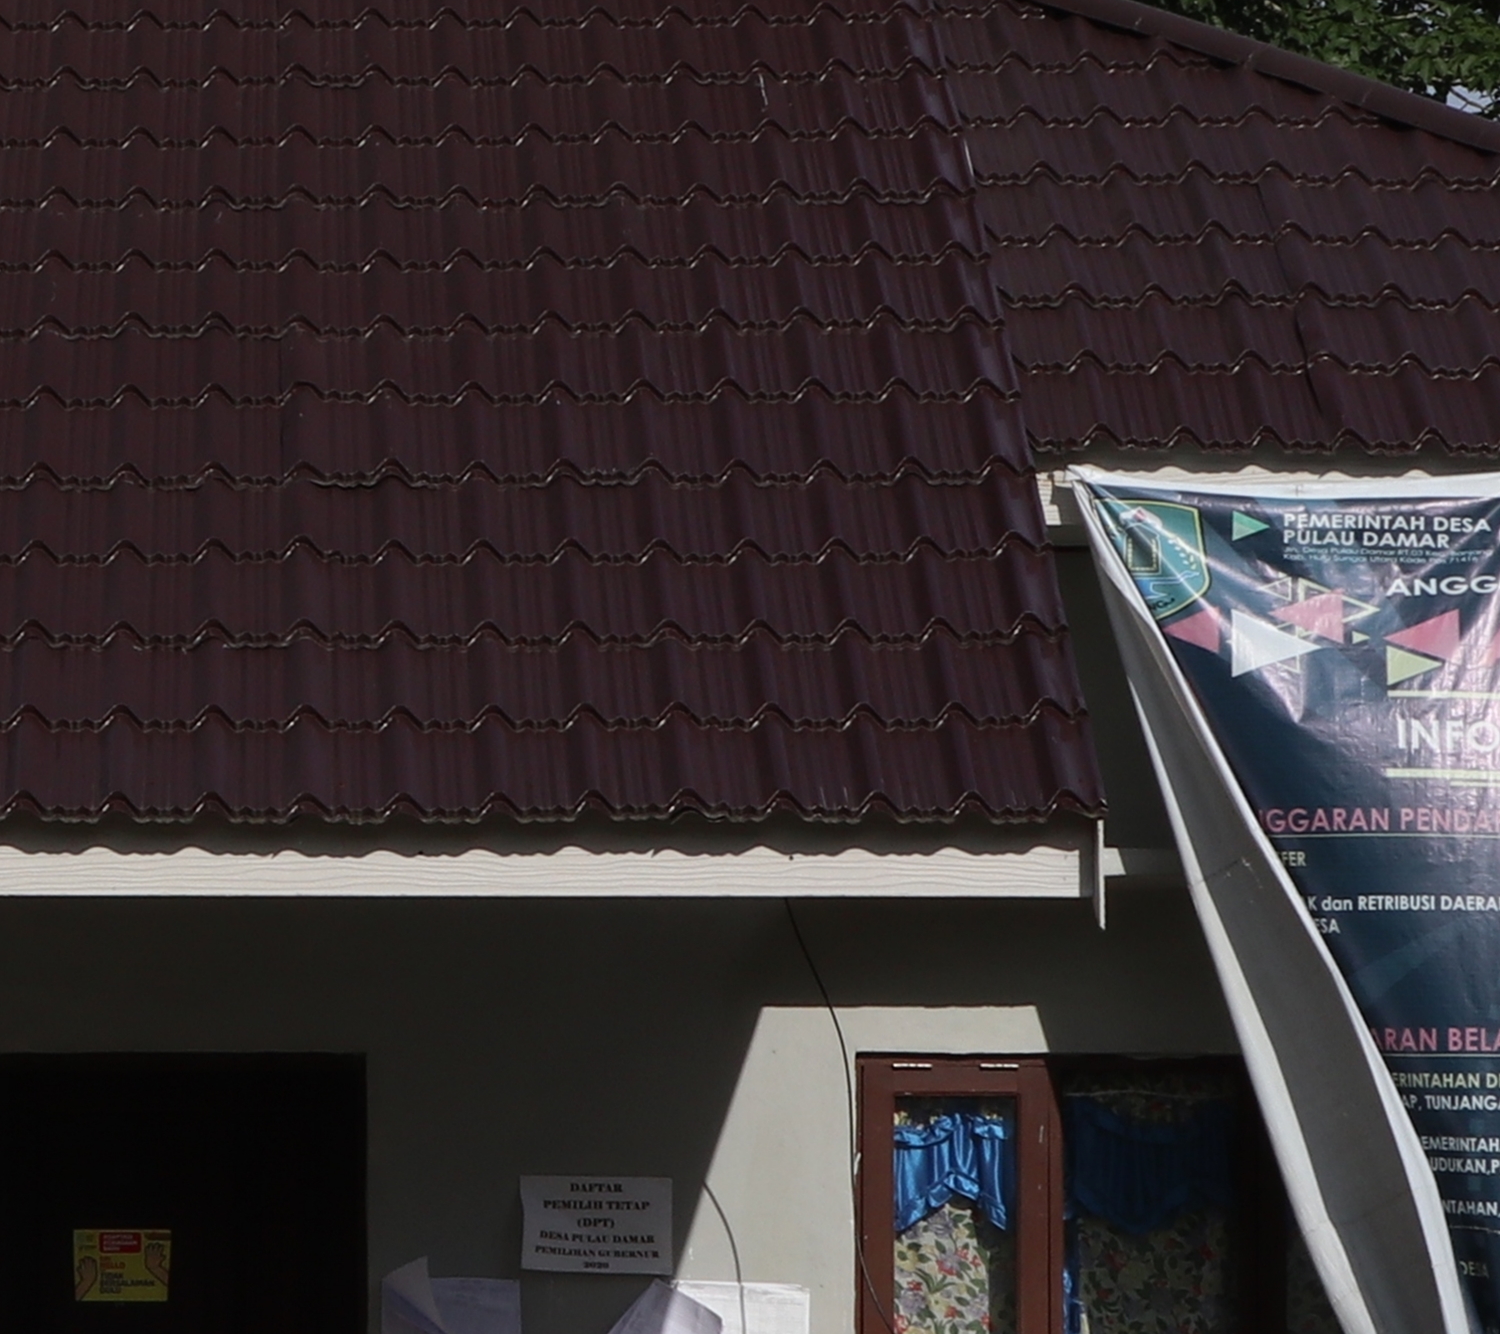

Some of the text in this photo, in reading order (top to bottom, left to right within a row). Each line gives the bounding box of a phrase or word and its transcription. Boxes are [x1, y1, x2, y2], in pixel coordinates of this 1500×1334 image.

[1283, 513, 1492, 533] PEMERINTAH DESA
[1283, 529, 1450, 549] PULAU DAMAR
[1321, 894, 1353, 911] dan
[1358, 895, 1436, 912] RETRIBUSI
[570, 1183, 623, 1193] DAFTAR
[543, 1199, 651, 1210] PEMILIH TETAP
[577, 1217, 615, 1229] (DPT)
[539, 1230, 655, 1244] DESA PULAU DAMAR
[534, 1245, 660, 1258] PEMILIHAN GUBERNUR
